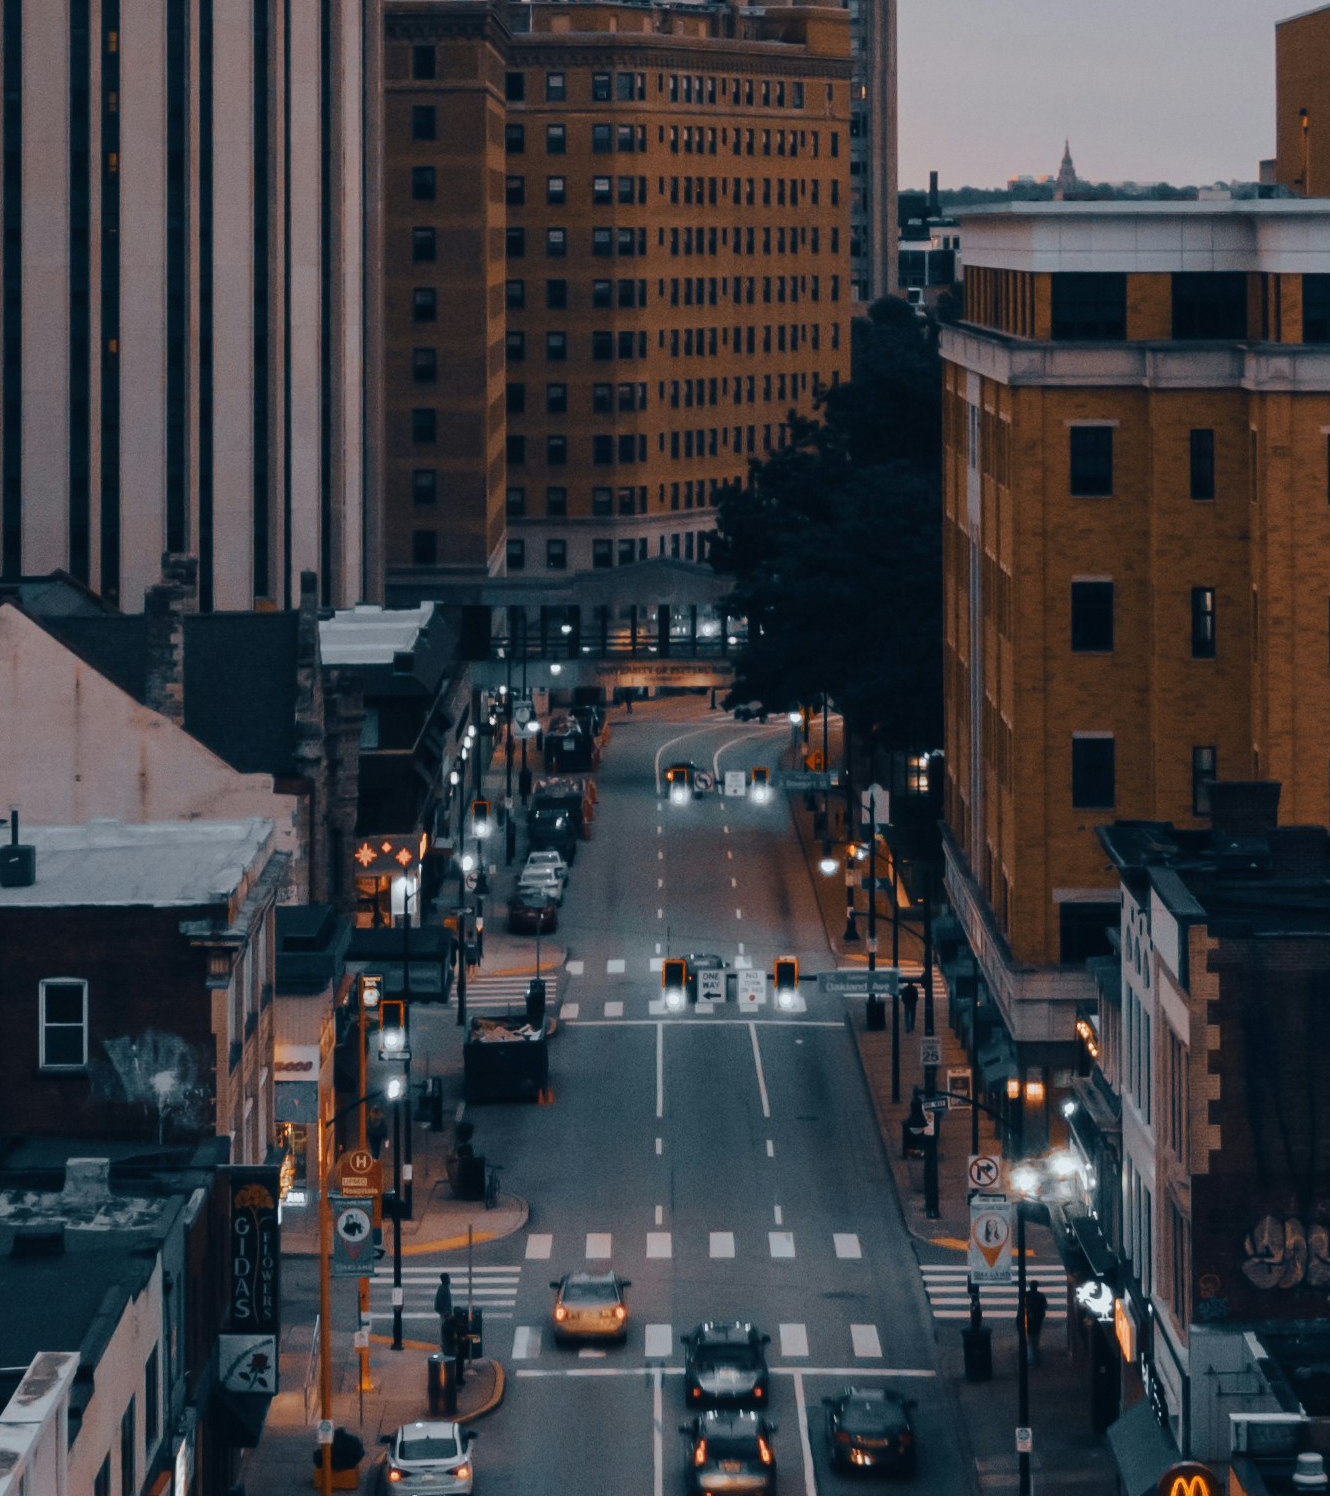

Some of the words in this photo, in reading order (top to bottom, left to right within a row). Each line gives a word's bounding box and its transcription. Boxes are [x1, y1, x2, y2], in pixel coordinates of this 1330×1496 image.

[702, 972, 720, 981] ONE
[745, 971, 758, 979] NO
[702, 981, 721, 990] WAY
[826, 981, 868, 992] Oakland
[871, 982, 891, 992] Ave
[922, 1051, 940, 1062] 25
[234, 1217, 251, 1319] GIDAS
[262, 1231, 274, 1320] FLOWERS
